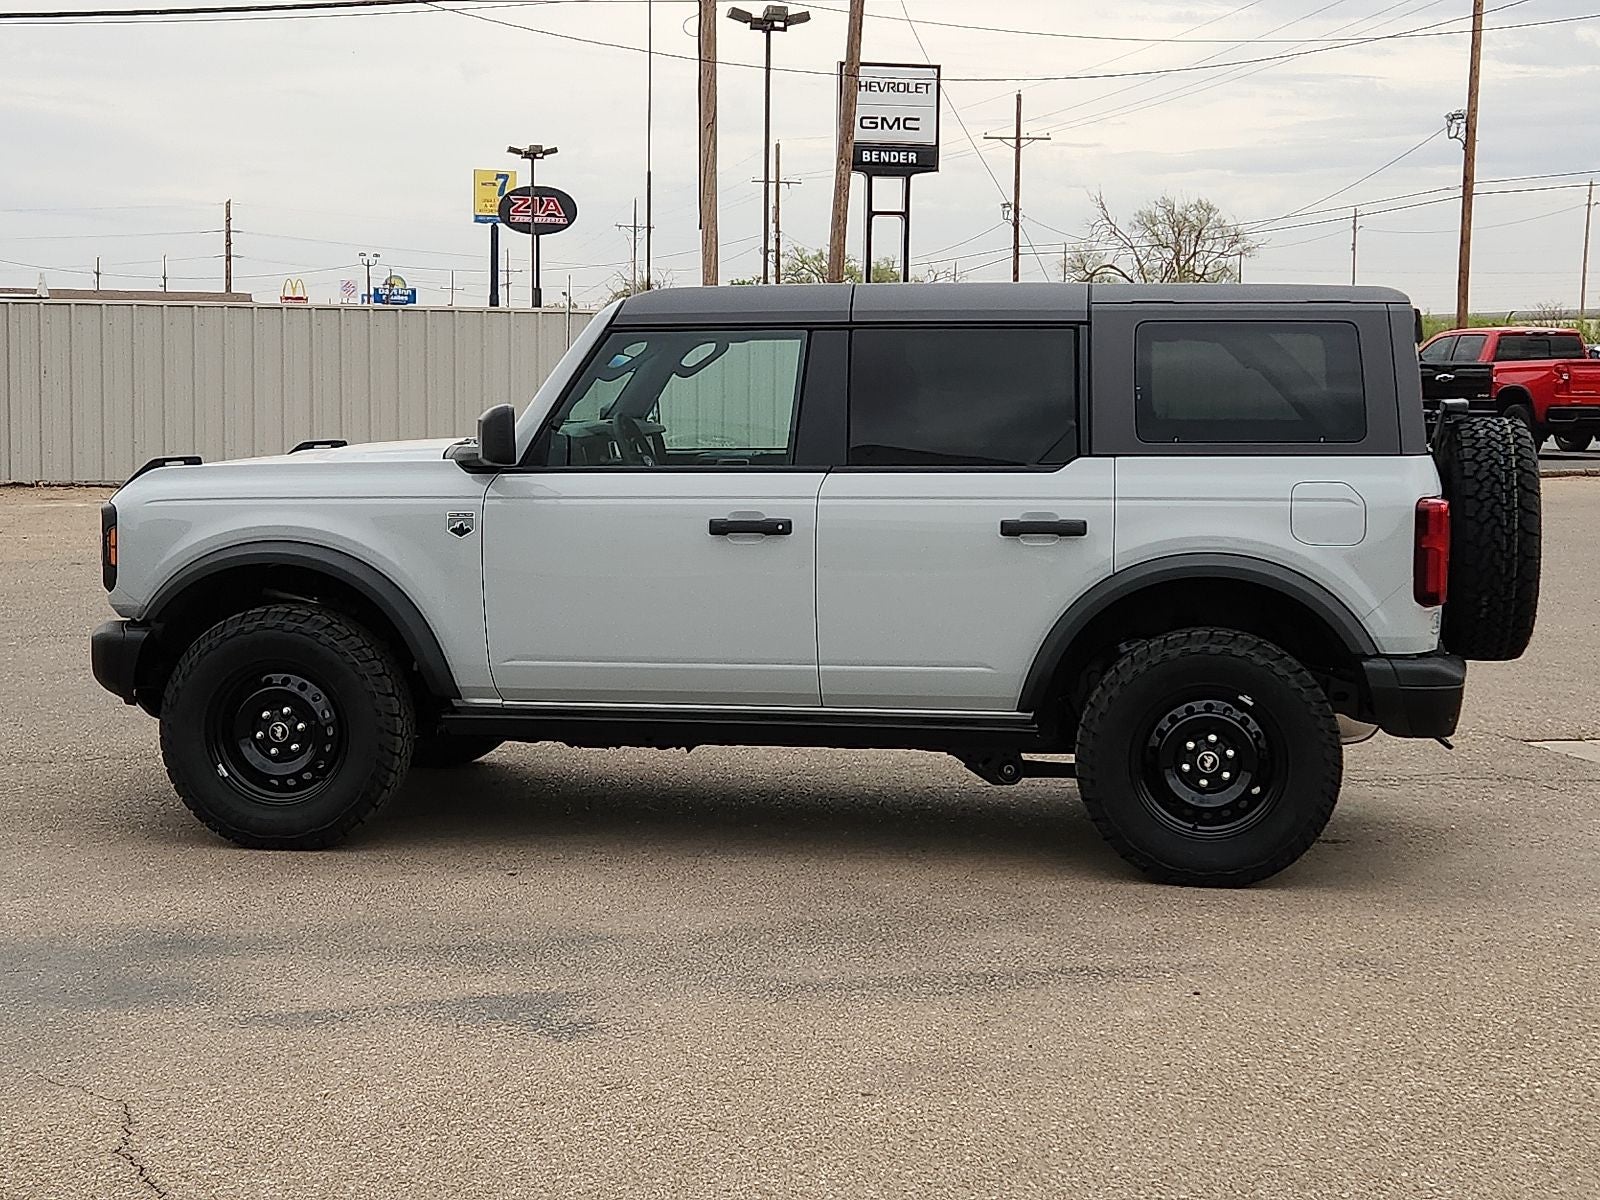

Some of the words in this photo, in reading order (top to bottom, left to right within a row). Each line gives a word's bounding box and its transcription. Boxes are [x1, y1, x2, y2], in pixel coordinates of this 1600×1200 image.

[859, 80, 932, 94] HEVROLET
[859, 116, 921, 131] GMC
[862, 150, 917, 164] BENDER
[495, 173, 509, 197] 7
[509, 195, 565, 217] ZIA
